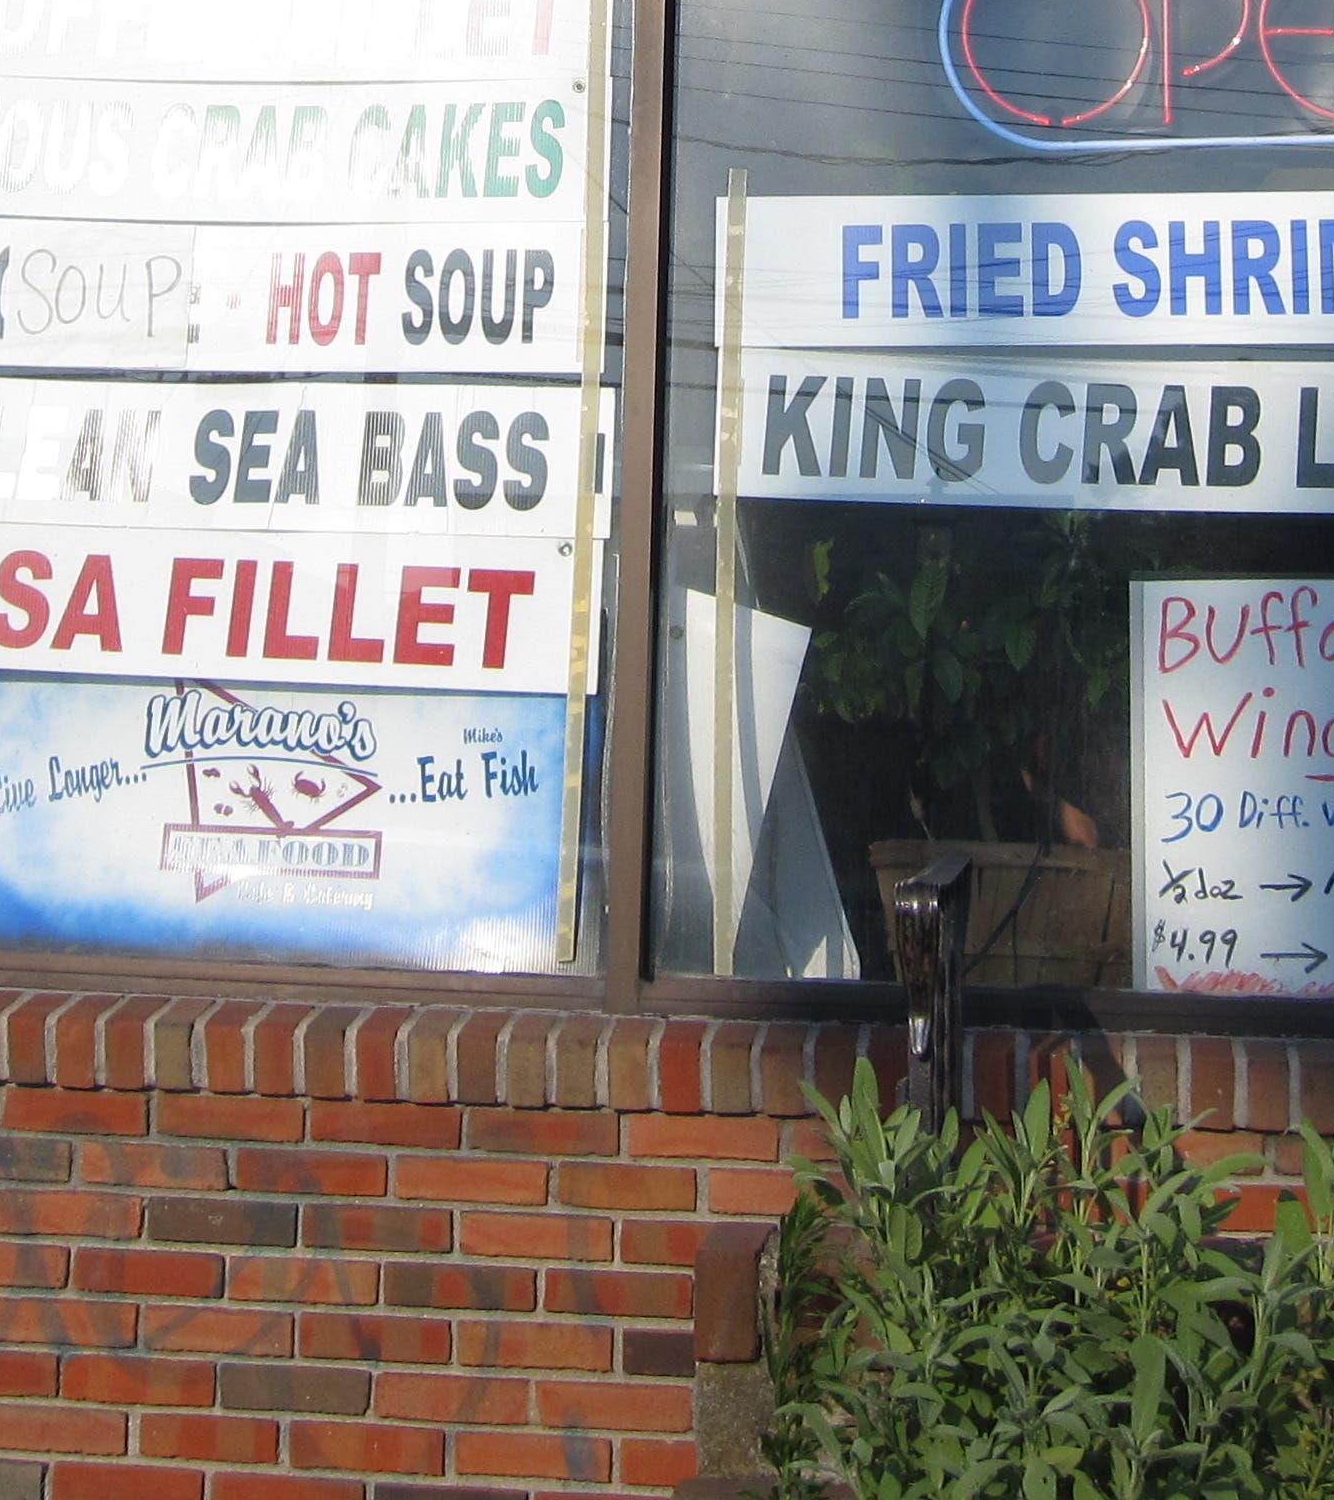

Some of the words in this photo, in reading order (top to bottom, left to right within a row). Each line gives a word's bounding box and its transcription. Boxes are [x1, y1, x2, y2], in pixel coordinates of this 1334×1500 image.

[154, 102, 328, 201] CRAB
[349, 99, 568, 201] CAKES
[265, 251, 382, 346] HOT
[401, 247, 555, 347] SOUP
[841, 221, 1082, 320] FRIED
[188, 408, 321, 507] SEA
[357, 409, 551, 511] BASS
[762, 374, 988, 482] KING
[1019, 381, 1264, 489] CRAB
[160, 556, 536, 670] FILLET
[144, 689, 377, 761] Marano's
[463, 727, 503, 744] Mike's
[481, 749, 540, 798] Fish
[1161, 791, 1225, 843] 30
[1239, 790, 1311, 829] Diff.
[1153, 919, 1239, 968] $4.99
